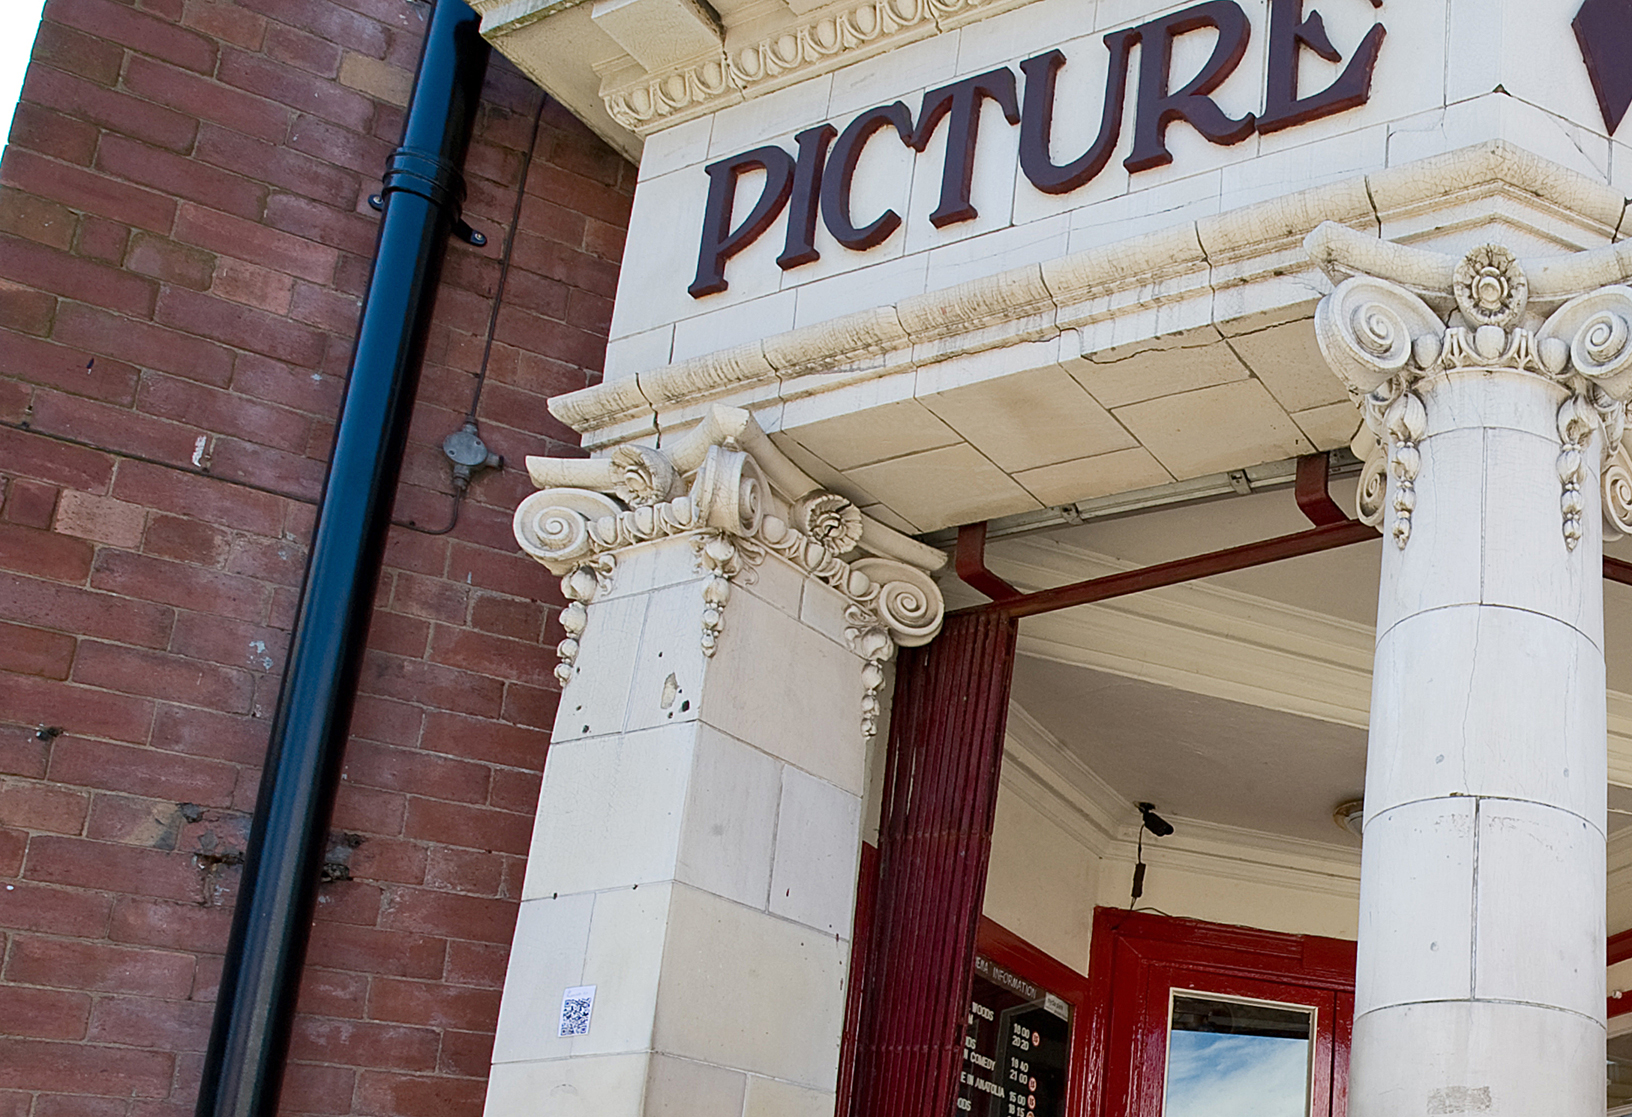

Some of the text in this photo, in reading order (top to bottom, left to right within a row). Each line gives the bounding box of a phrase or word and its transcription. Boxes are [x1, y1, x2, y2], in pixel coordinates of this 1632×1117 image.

[687, 0, 1387, 299] PICTURE
[992, 967, 1037, 999] INFORMATION
[972, 1001, 995, 1021] WOODS
[970, 1051, 996, 1071] COMEDY
[974, 1077, 1005, 1099] ANATOLIA
